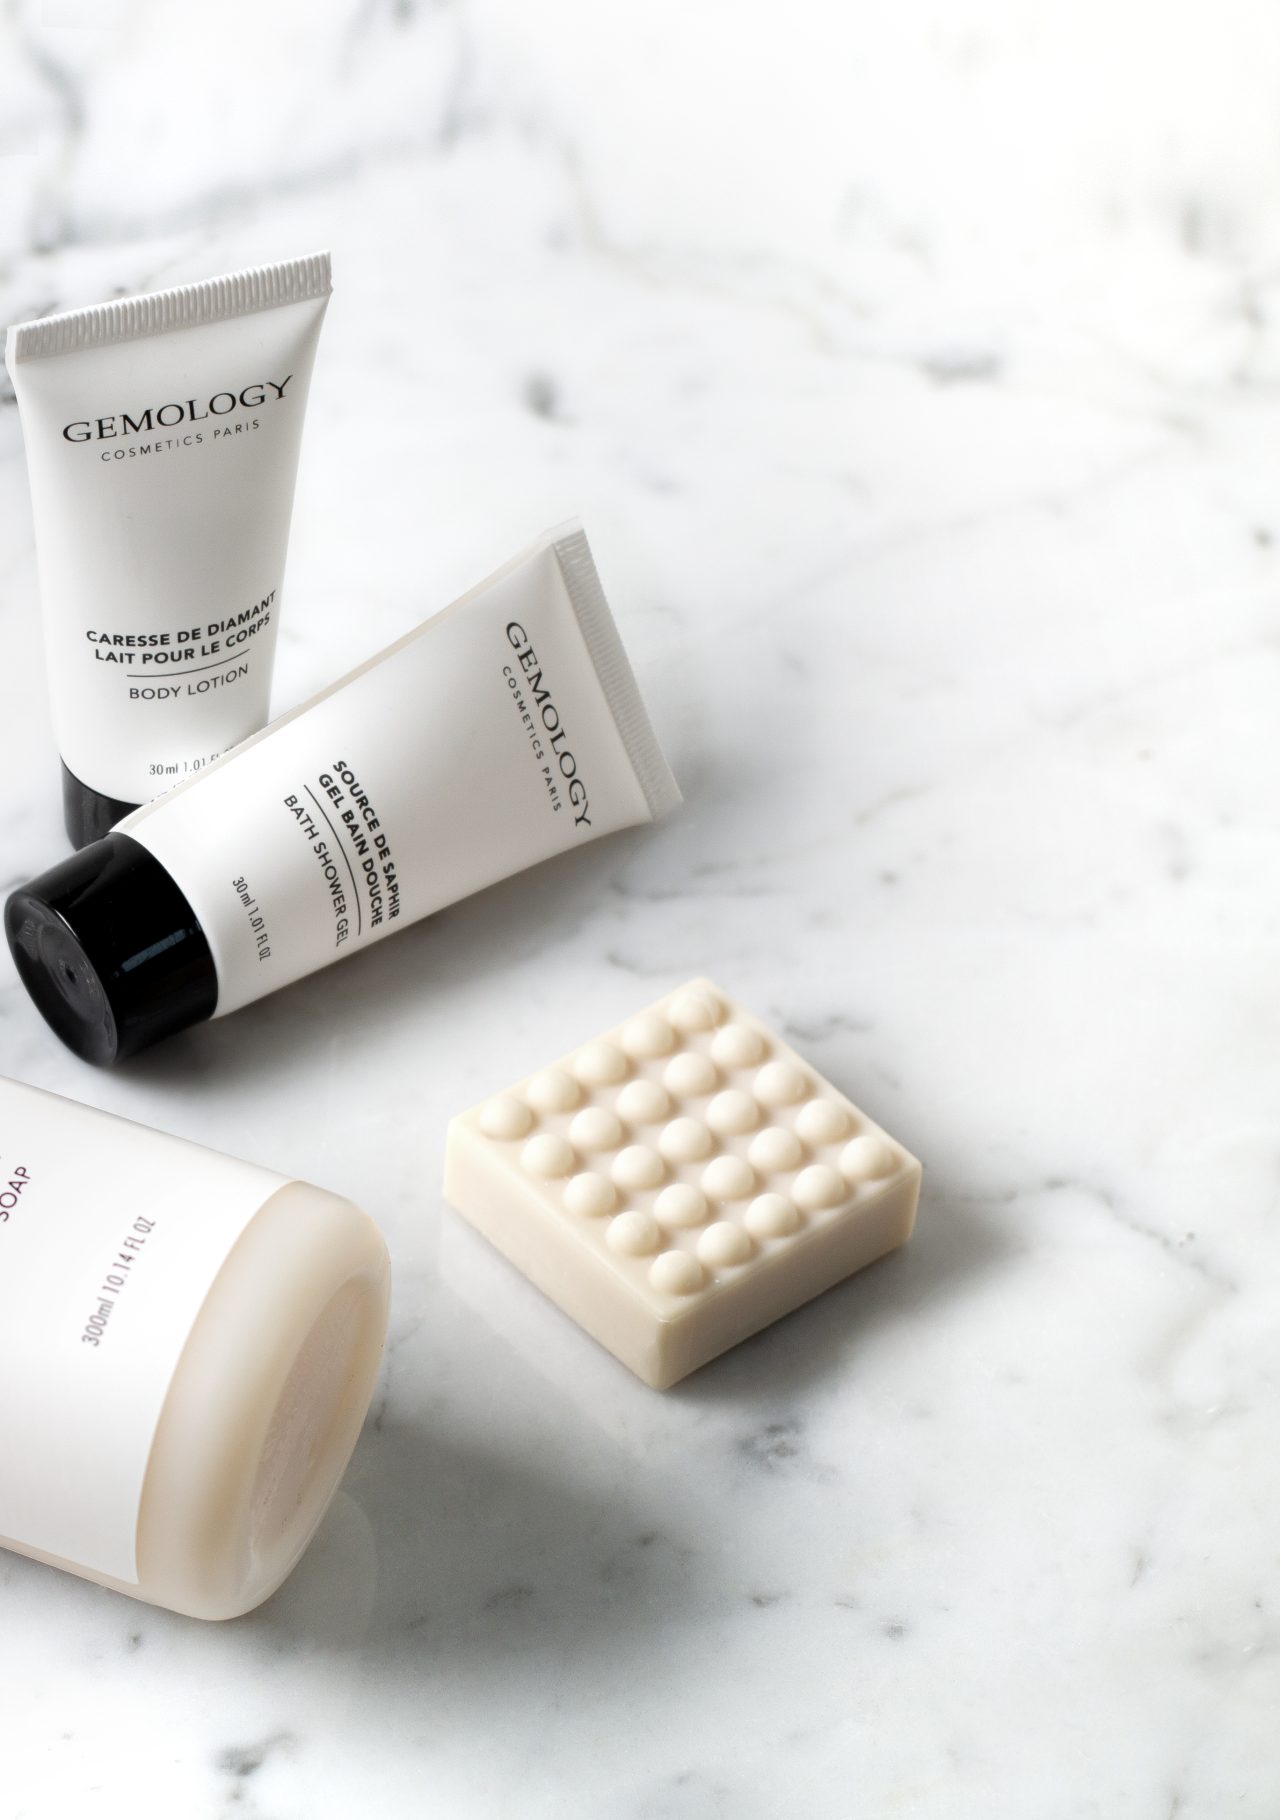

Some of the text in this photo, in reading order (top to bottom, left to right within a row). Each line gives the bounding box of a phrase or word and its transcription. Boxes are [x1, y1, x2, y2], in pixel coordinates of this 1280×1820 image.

[63, 375, 293, 443] GEMOLOGY
[101, 419, 260, 462] COSMETICS PARIS
[86, 590, 275, 647] CARESSE DE DIAMANT
[95, 612, 270, 664] LAIT POUR LE CORPS
[130, 663, 248, 700] BODY LOTION
[502, 666, 561, 812] COSMETICS PARIS
[506, 622, 591, 827] GEMOLOGY
[184, 758, 206, 772] 1.01
[283, 795, 349, 947] BATH SHOWER GEL
[319, 774, 383, 928] GEL BAIN DOUCHE
[333, 760, 400, 920] SOURCE DE SAPHIR
[248, 906, 265, 933] 1.01
[256, 933, 268, 948] FL
[81, 1216, 156, 1347] 300ml 10.14 FL OZ
